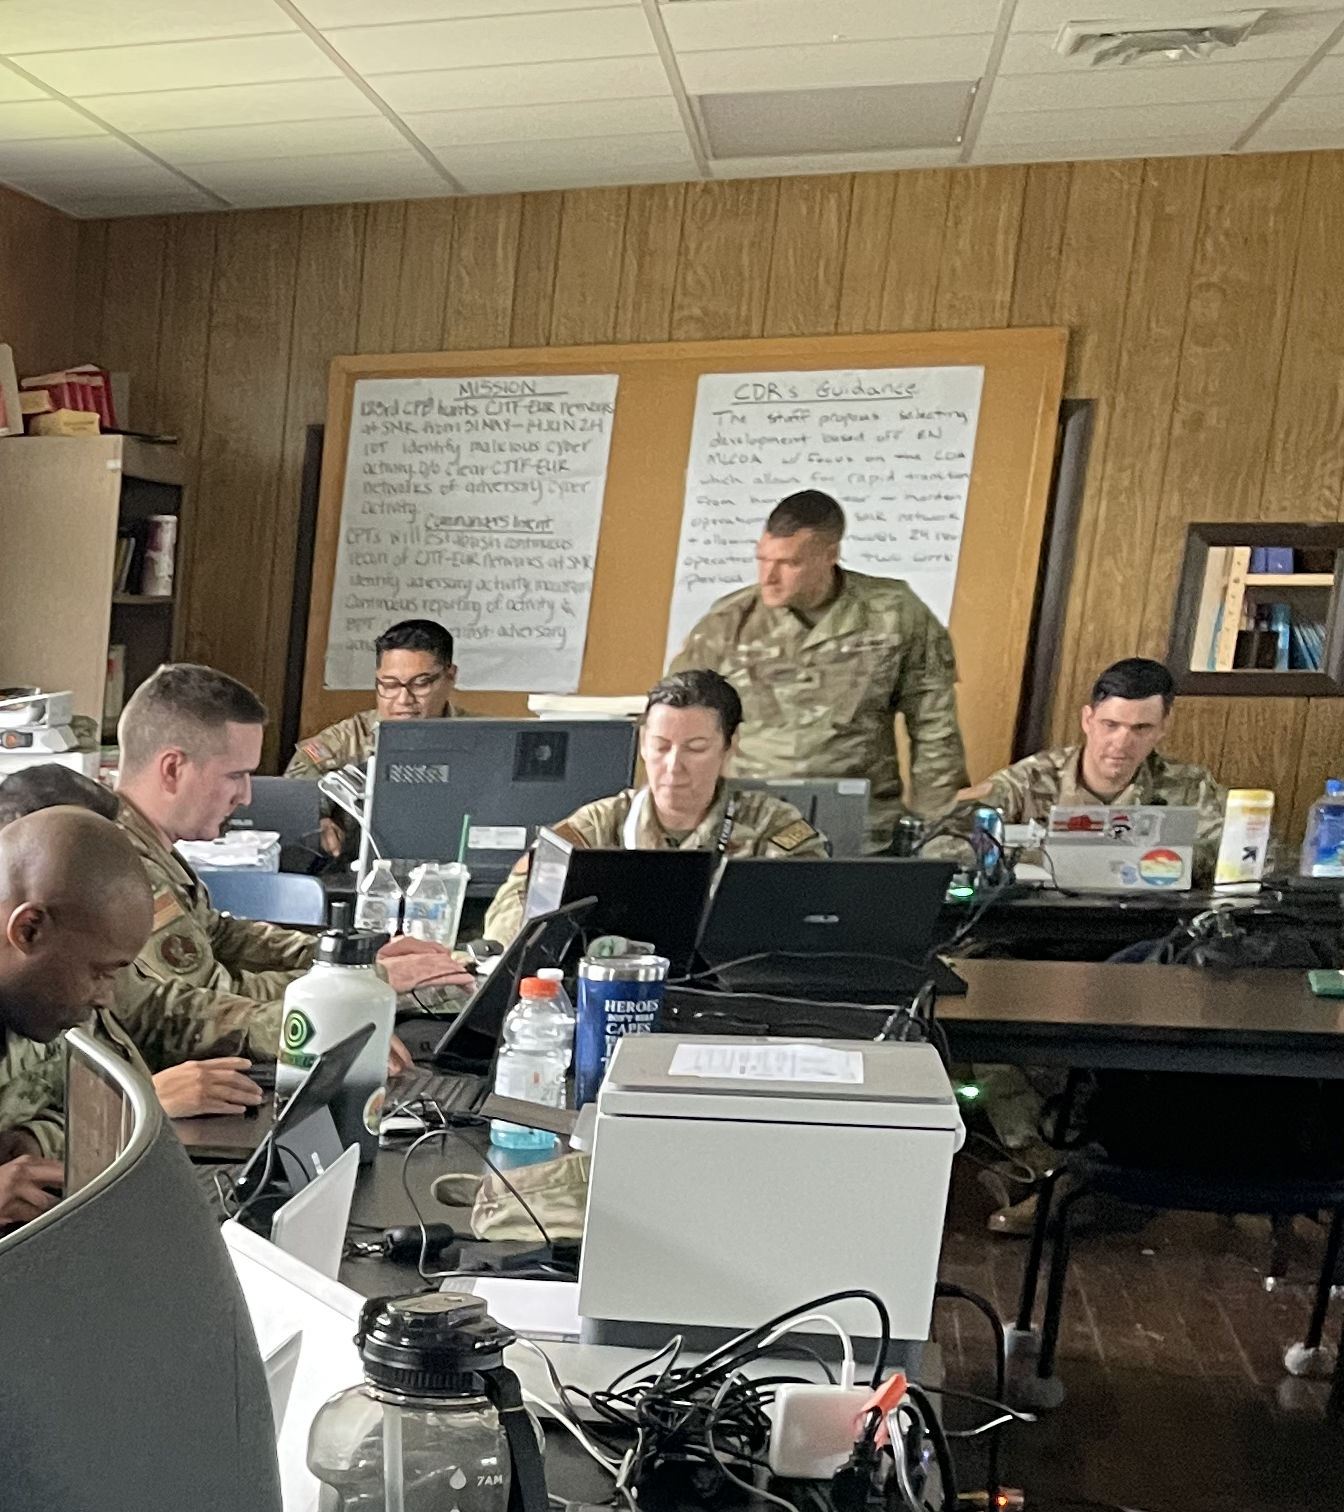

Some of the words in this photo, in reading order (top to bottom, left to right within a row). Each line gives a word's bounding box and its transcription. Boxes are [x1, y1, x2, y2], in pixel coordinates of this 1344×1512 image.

[458, 380, 536, 397] MISSION
[816, 379, 919, 398] Guidance
[476, 1474, 503, 1487] 7AM
